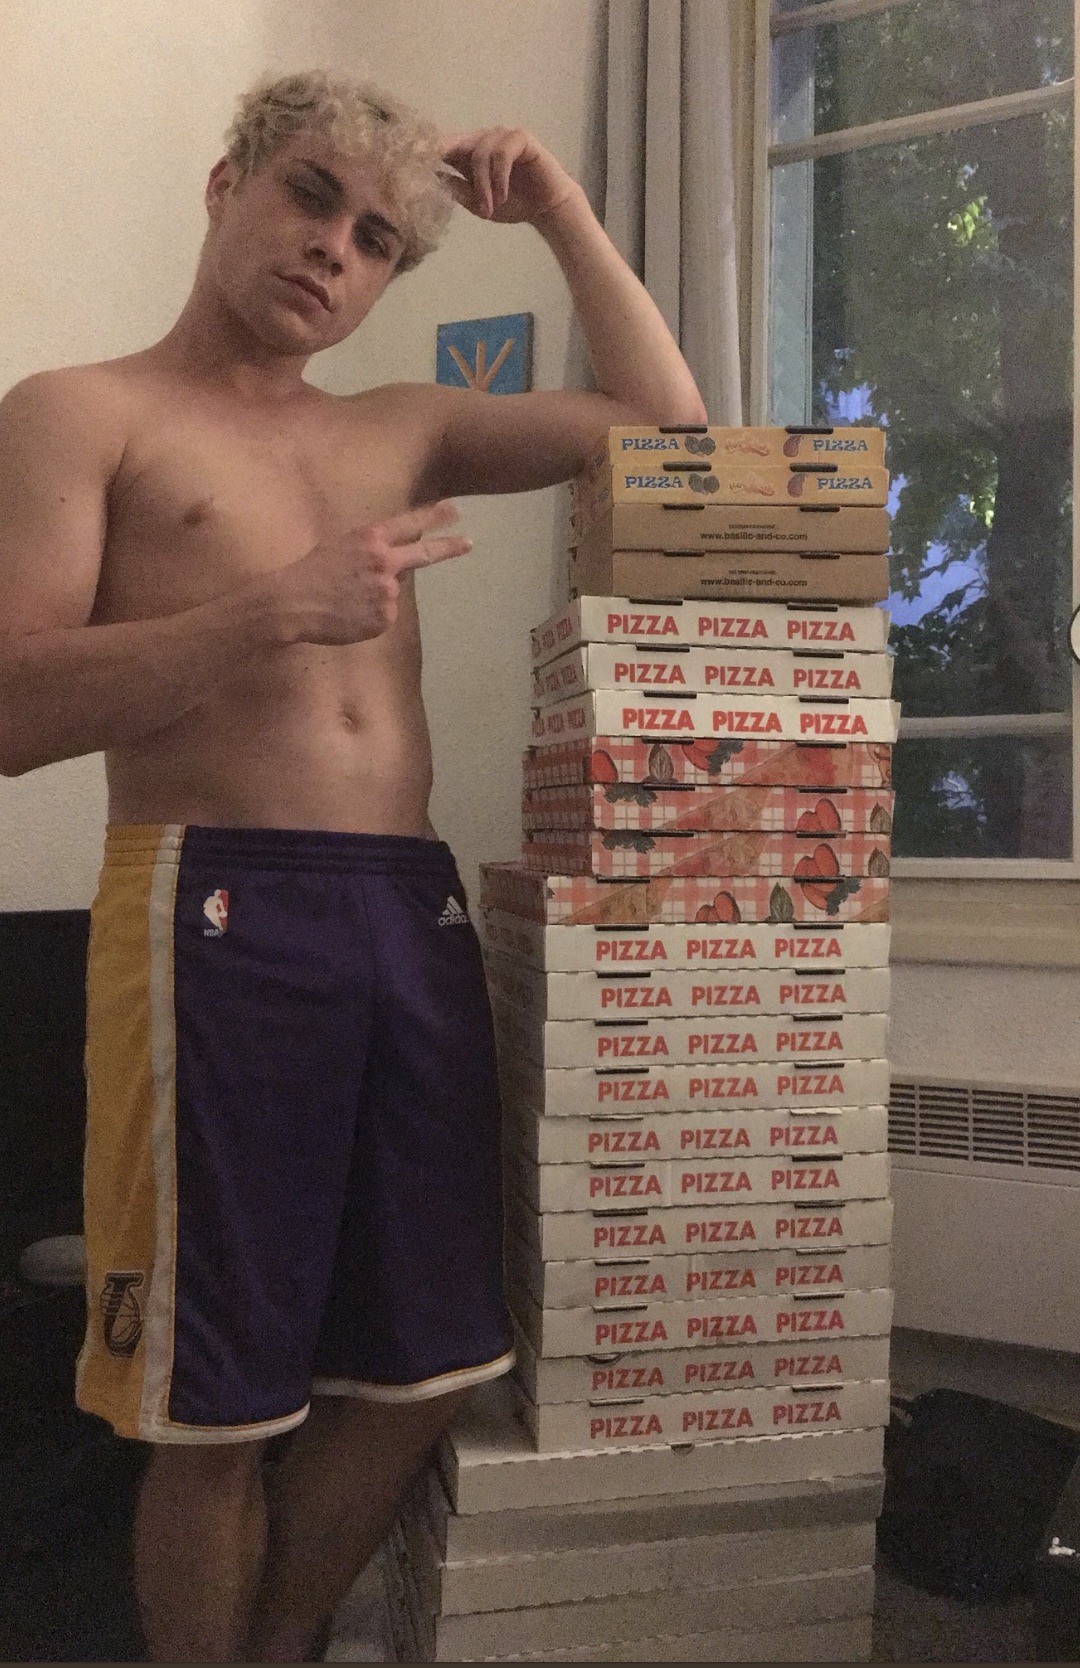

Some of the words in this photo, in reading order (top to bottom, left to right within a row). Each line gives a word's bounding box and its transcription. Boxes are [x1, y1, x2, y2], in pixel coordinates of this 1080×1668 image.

[621, 437, 680, 451] PIZZA
[813, 439, 868, 452] PIZZA
[624, 475, 684, 489] PIZZA
[816, 477, 873, 490] PIZZA
[607, 613, 679, 636] PIZZA
[697, 616, 769, 639] PIZZA
[786, 619, 855, 641] PIZZA
[614, 662, 686, 685] PIZZA
[704, 665, 774, 687] PIZZA
[792, 668, 861, 690] PIZZA
[622, 707, 695, 731] PIZZA
[711, 711, 782, 734] PIZZA
[799, 713, 867, 735] PIZZA
[595, 939, 667, 961] PIZZA
[686, 938, 756, 960] PIZZA
[774, 937, 842, 959] PIZZA
[600, 986, 672, 1009] PIZZA
[690, 984, 761, 1006] PIZZA
[779, 983, 846, 1005] PIZZA
[596, 1035, 668, 1057] PIZZA
[687, 1033, 758, 1055] PIZZA
[775, 1030, 842, 1053] PIZZA
[597, 1078, 670, 1102] PIZZA
[688, 1076, 759, 1098] PIZZA
[776, 1073, 845, 1095] PIZZA
[587, 1130, 660, 1153] PIZZA
[679, 1127, 751, 1150] PIZZA
[768, 1125, 838, 1147] PIZZA
[588, 1174, 662, 1198] PIZZA
[679, 1171, 752, 1194] PIZZA
[769, 1167, 840, 1190] PIZZA
[592, 1223, 666, 1248] PIZZA
[683, 1219, 756, 1244] PIZZA
[774, 1215, 843, 1239] PIZZA
[594, 1273, 666, 1297] PIZZA
[686, 1268, 756, 1291] PIZZA
[774, 1263, 843, 1287] PIZZA
[595, 1320, 668, 1345] PIZZA
[686, 1314, 758, 1339] PIZZA
[775, 1309, 845, 1334] PIZZA
[591, 1367, 665, 1390] PIZZA
[683, 1359, 754, 1384] PIZZA
[773, 1354, 843, 1377] PIZZA
[589, 1413, 663, 1439] PIZZA
[681, 1407, 752, 1431] PIZZA
[771, 1401, 842, 1425] PIZZA
